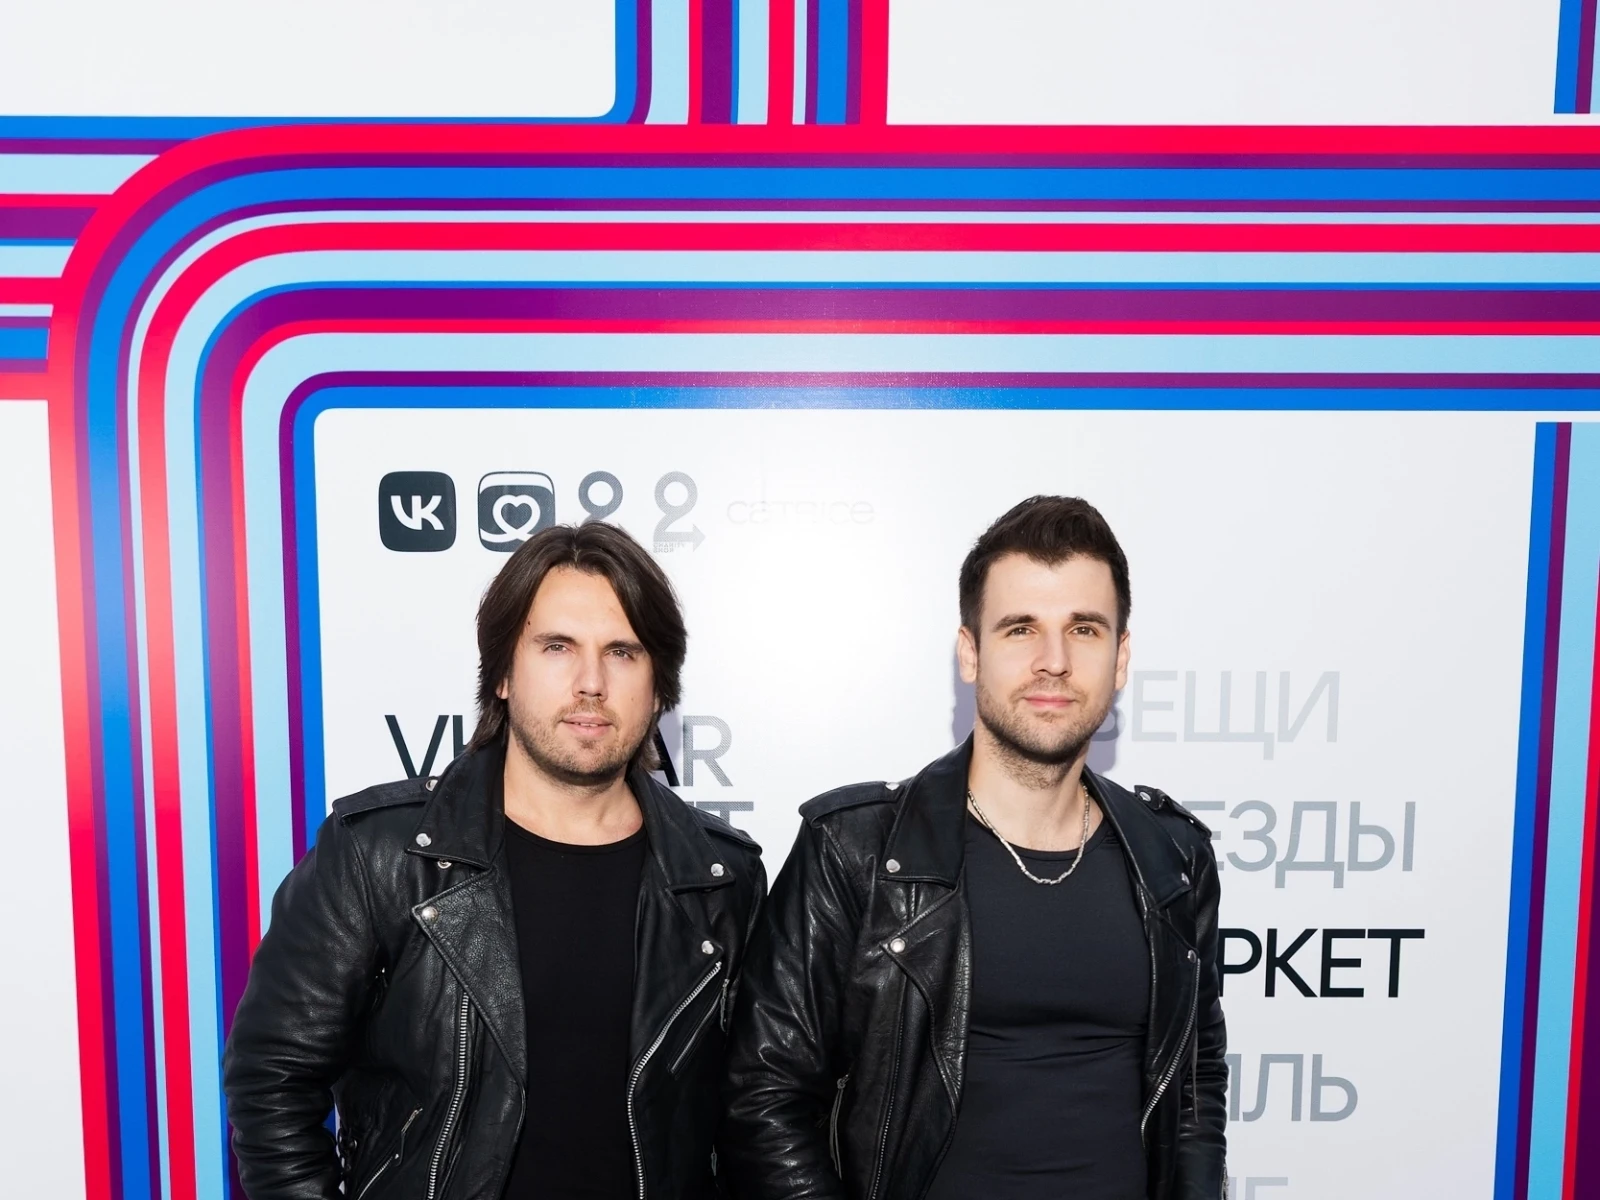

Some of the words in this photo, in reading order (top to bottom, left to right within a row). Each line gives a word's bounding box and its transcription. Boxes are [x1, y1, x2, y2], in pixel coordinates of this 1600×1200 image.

[390, 494, 445, 531] VK
[1091, 670, 1341, 761] ЕЩИ
[1182, 800, 1416, 889] ЗДЫ
[1217, 928, 1425, 998] РКЕТ
